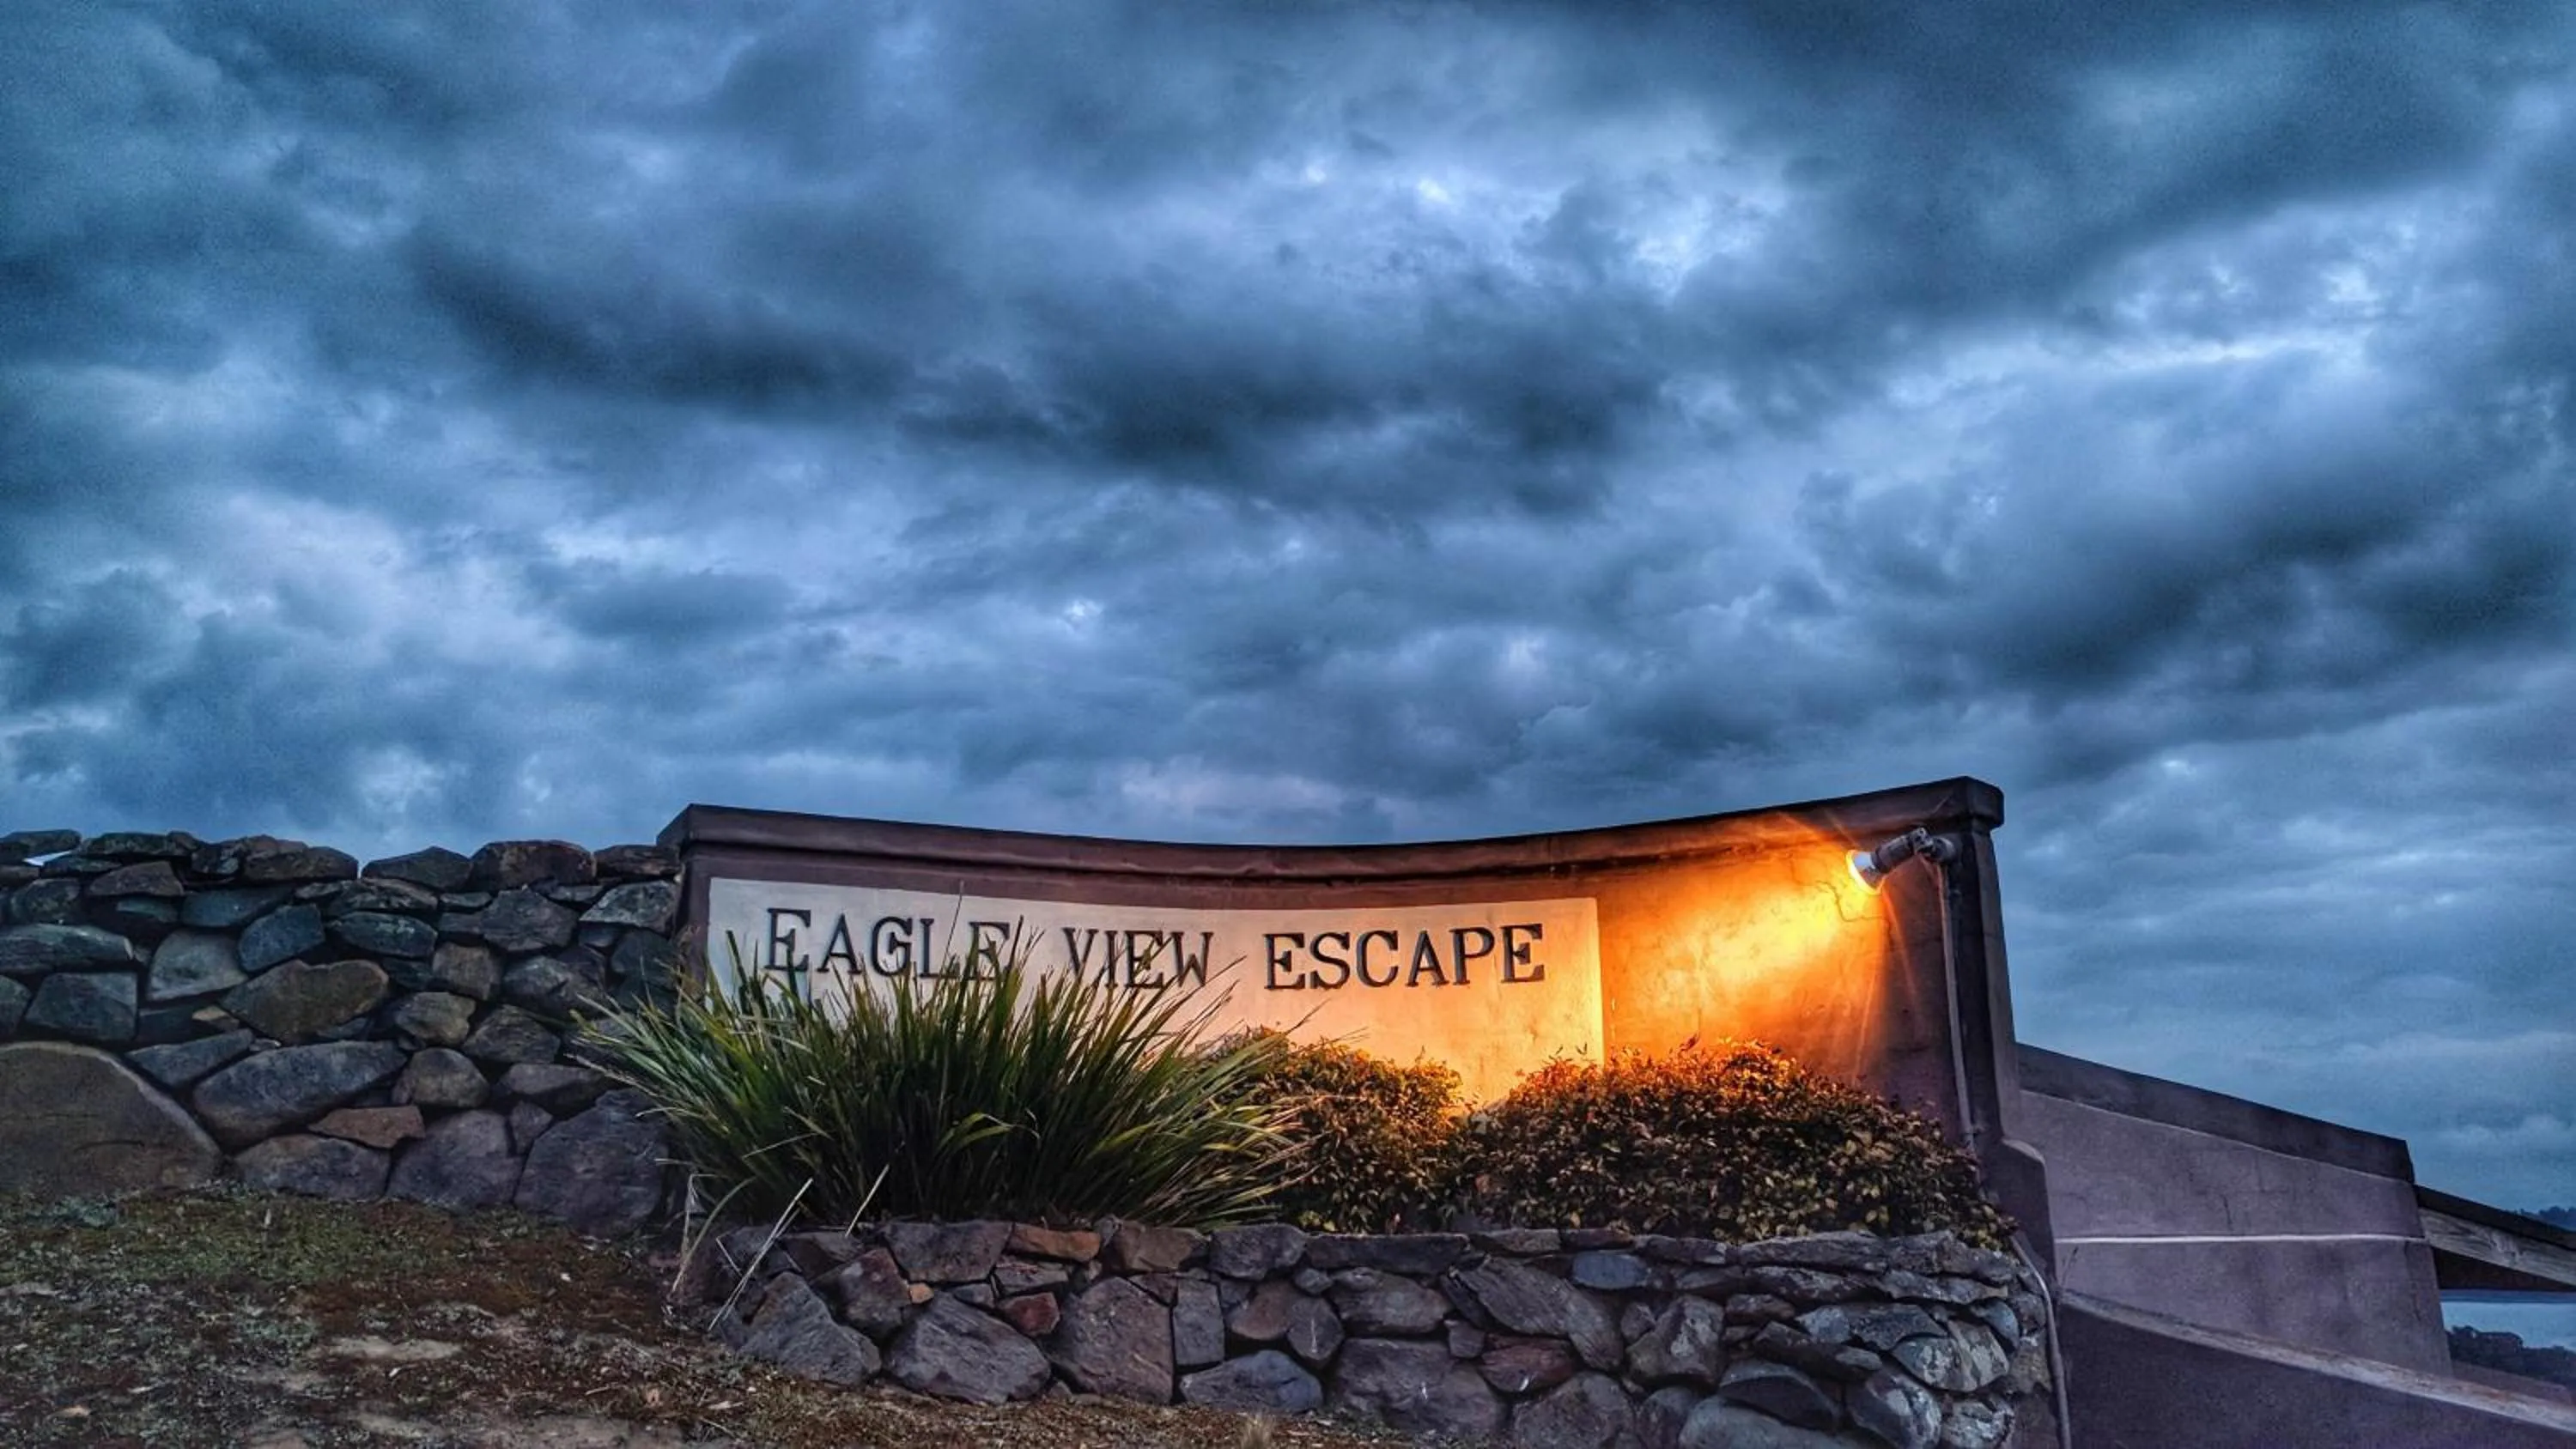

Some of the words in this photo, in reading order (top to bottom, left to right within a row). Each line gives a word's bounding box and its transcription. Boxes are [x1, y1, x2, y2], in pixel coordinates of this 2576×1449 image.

[763, 907, 1012, 981] EAGLE
[1063, 926, 1214, 989] VIEW
[1263, 923, 1546, 991] ESCAPE
